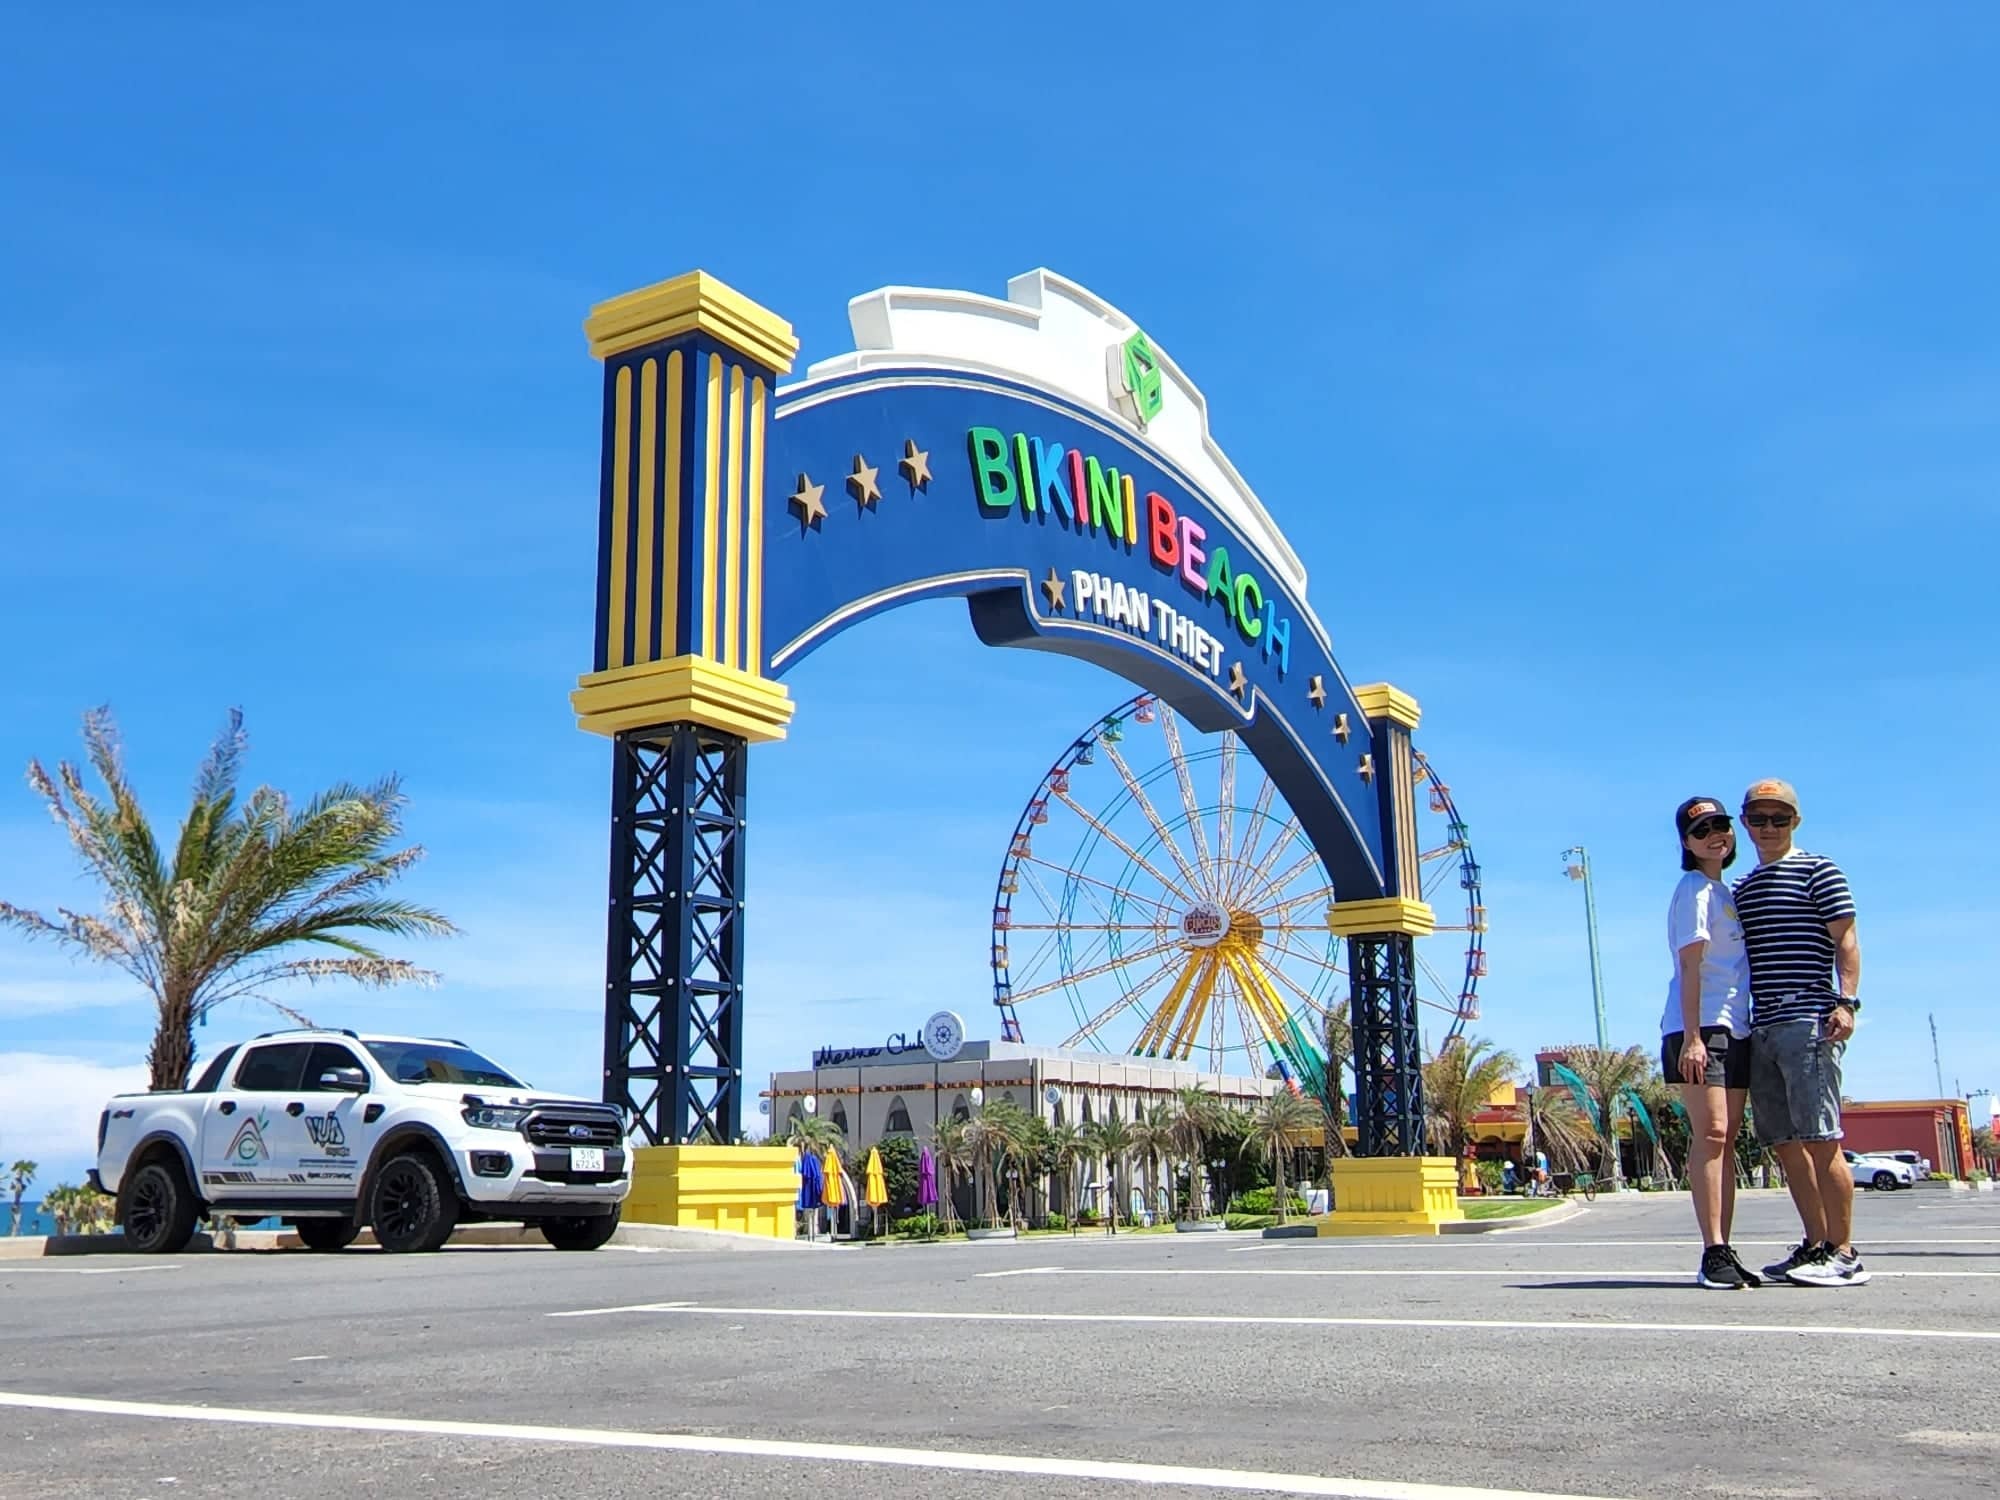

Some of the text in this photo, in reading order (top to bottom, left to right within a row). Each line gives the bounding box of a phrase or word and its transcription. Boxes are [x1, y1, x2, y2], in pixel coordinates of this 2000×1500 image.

[968, 426, 1289, 674] BIKINI BEACH
[1072, 569, 1225, 677] PHAN THIET
[816, 1044, 882, 1067] Marina
[886, 1029, 926, 1056] Club
